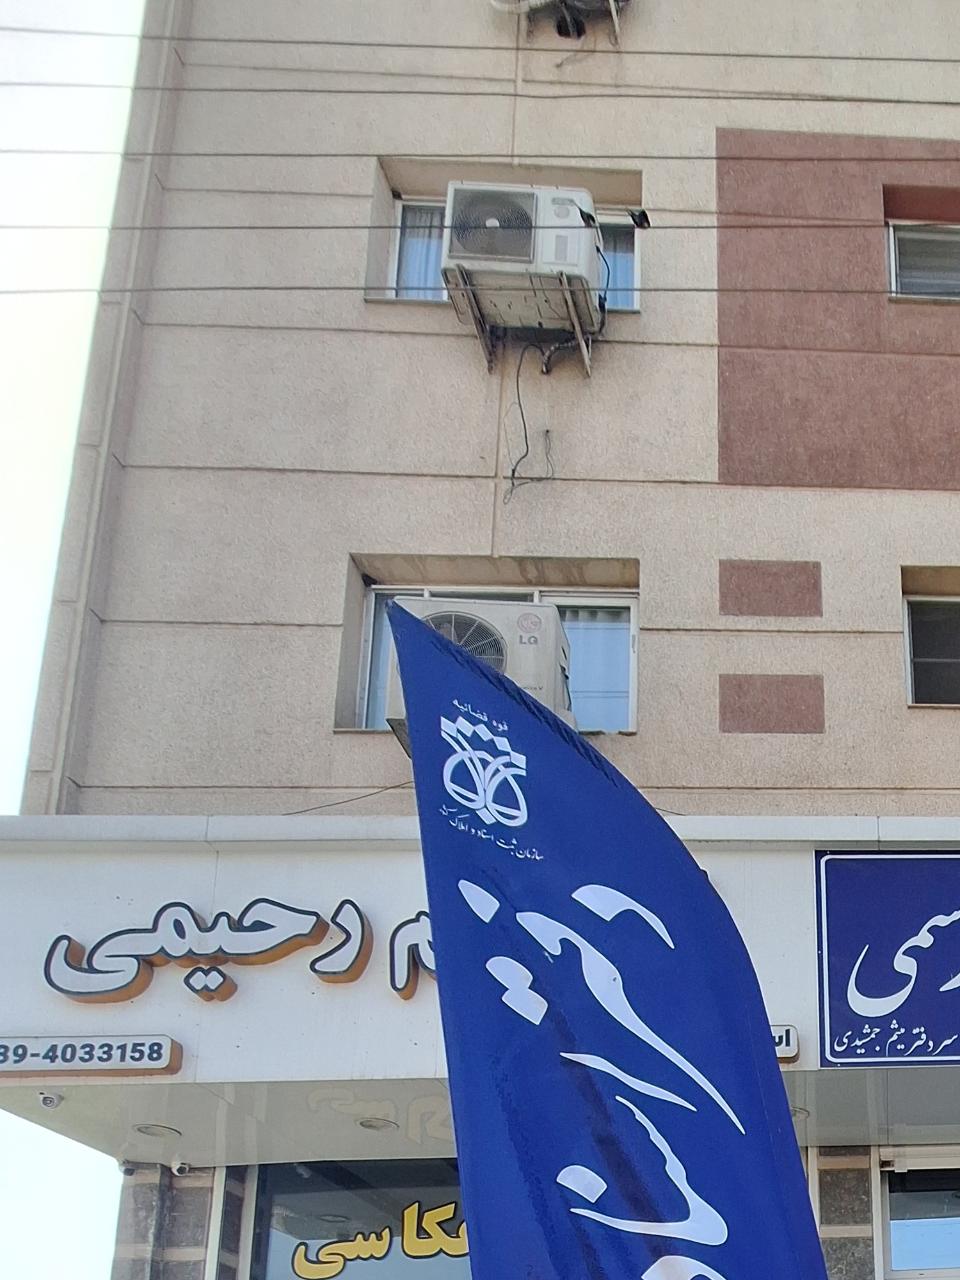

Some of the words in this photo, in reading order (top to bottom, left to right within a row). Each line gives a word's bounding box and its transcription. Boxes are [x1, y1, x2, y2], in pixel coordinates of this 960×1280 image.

[519, 634, 538, 645] LG
[496, 837, 517, 855] ثبت
[44, 898, 368, 1001] رحیمی
[458, 879, 746, 1135] دفتر
[834, 1024, 881, 1054] جمشیدی
[886, 1019, 906, 1057] میثم
